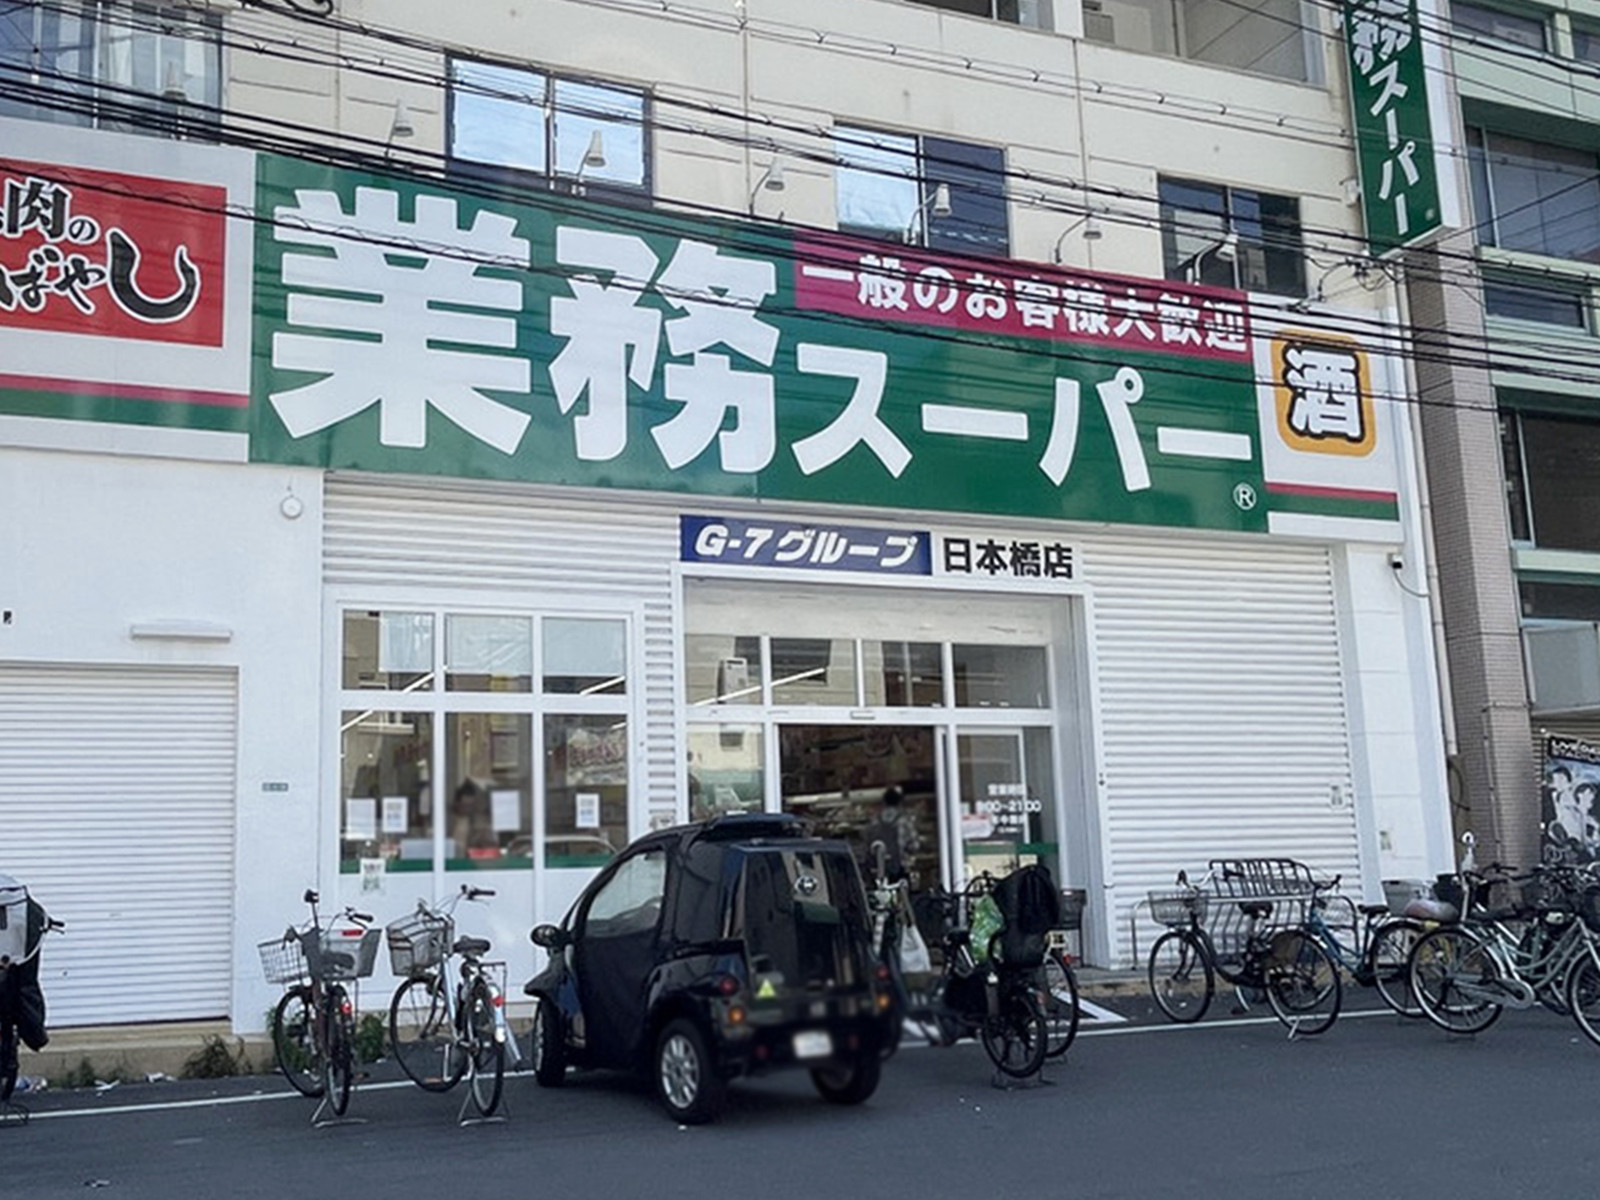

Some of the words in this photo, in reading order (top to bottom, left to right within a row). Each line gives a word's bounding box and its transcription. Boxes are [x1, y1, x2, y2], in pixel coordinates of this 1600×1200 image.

[0, 177, 99, 242] 肉の
[269, 186, 1253, 491] 業務スーパー
[802, 253, 1247, 352] 一般のお客様大歓迎
[1284, 342, 1365, 441] 酒
[943, 538, 1074, 579] 日本橋店
